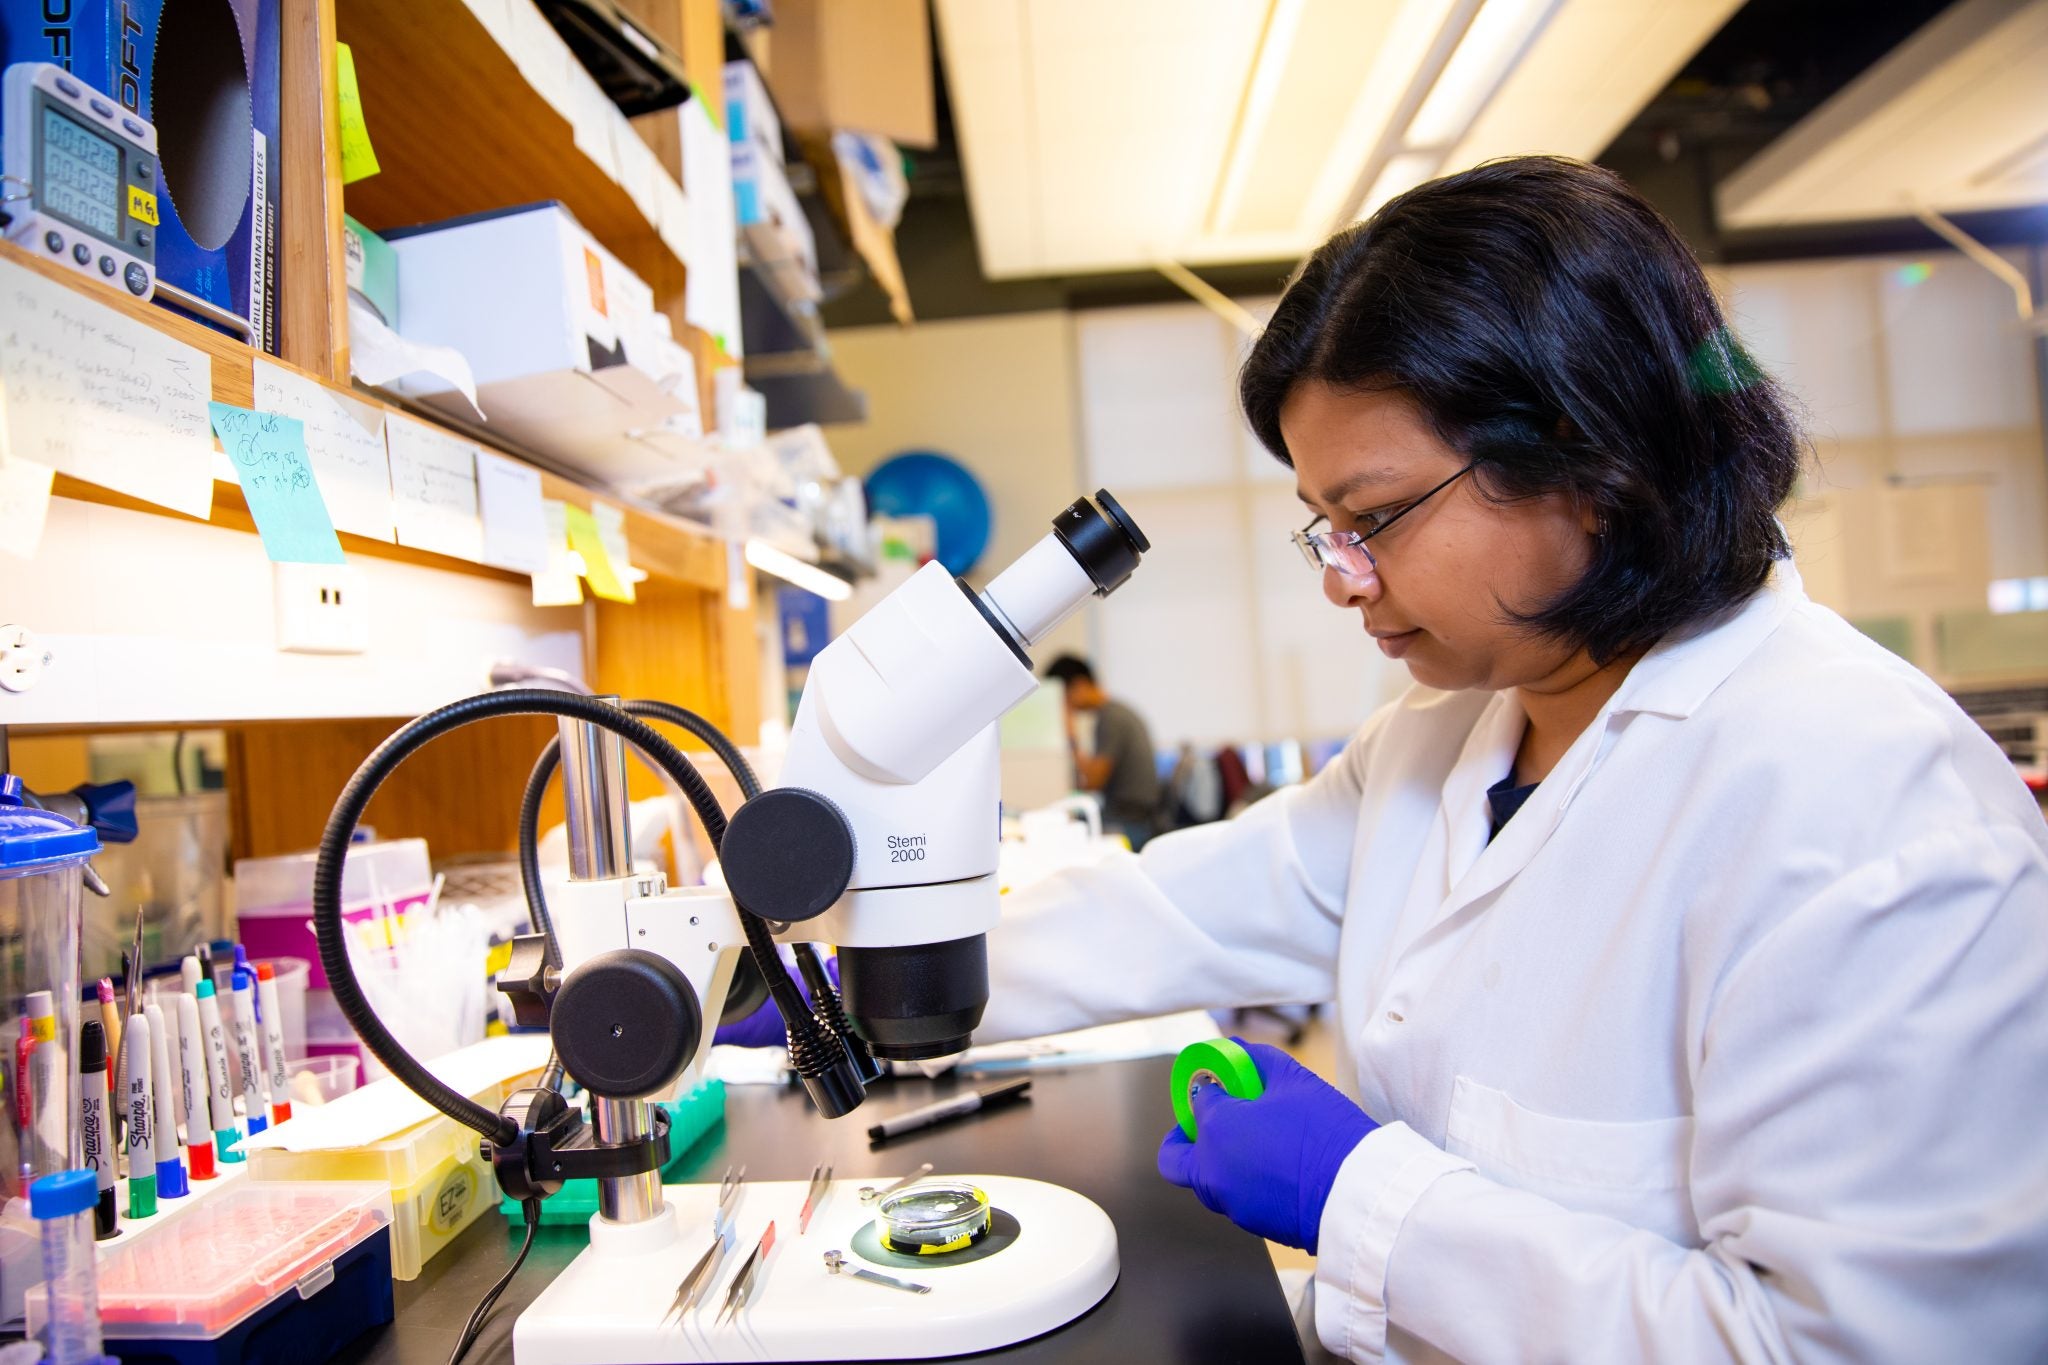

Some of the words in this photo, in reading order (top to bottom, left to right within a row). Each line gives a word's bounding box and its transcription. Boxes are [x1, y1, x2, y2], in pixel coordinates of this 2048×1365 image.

[254, 204, 263, 294] EXAMINATION
[266, 256, 274, 287] ADDS
[887, 833, 927, 849] Stemi
[891, 848, 925, 863] 2000
[84, 1113, 100, 1172] Sharpie
[131, 1098, 148, 1150] Sharpie
